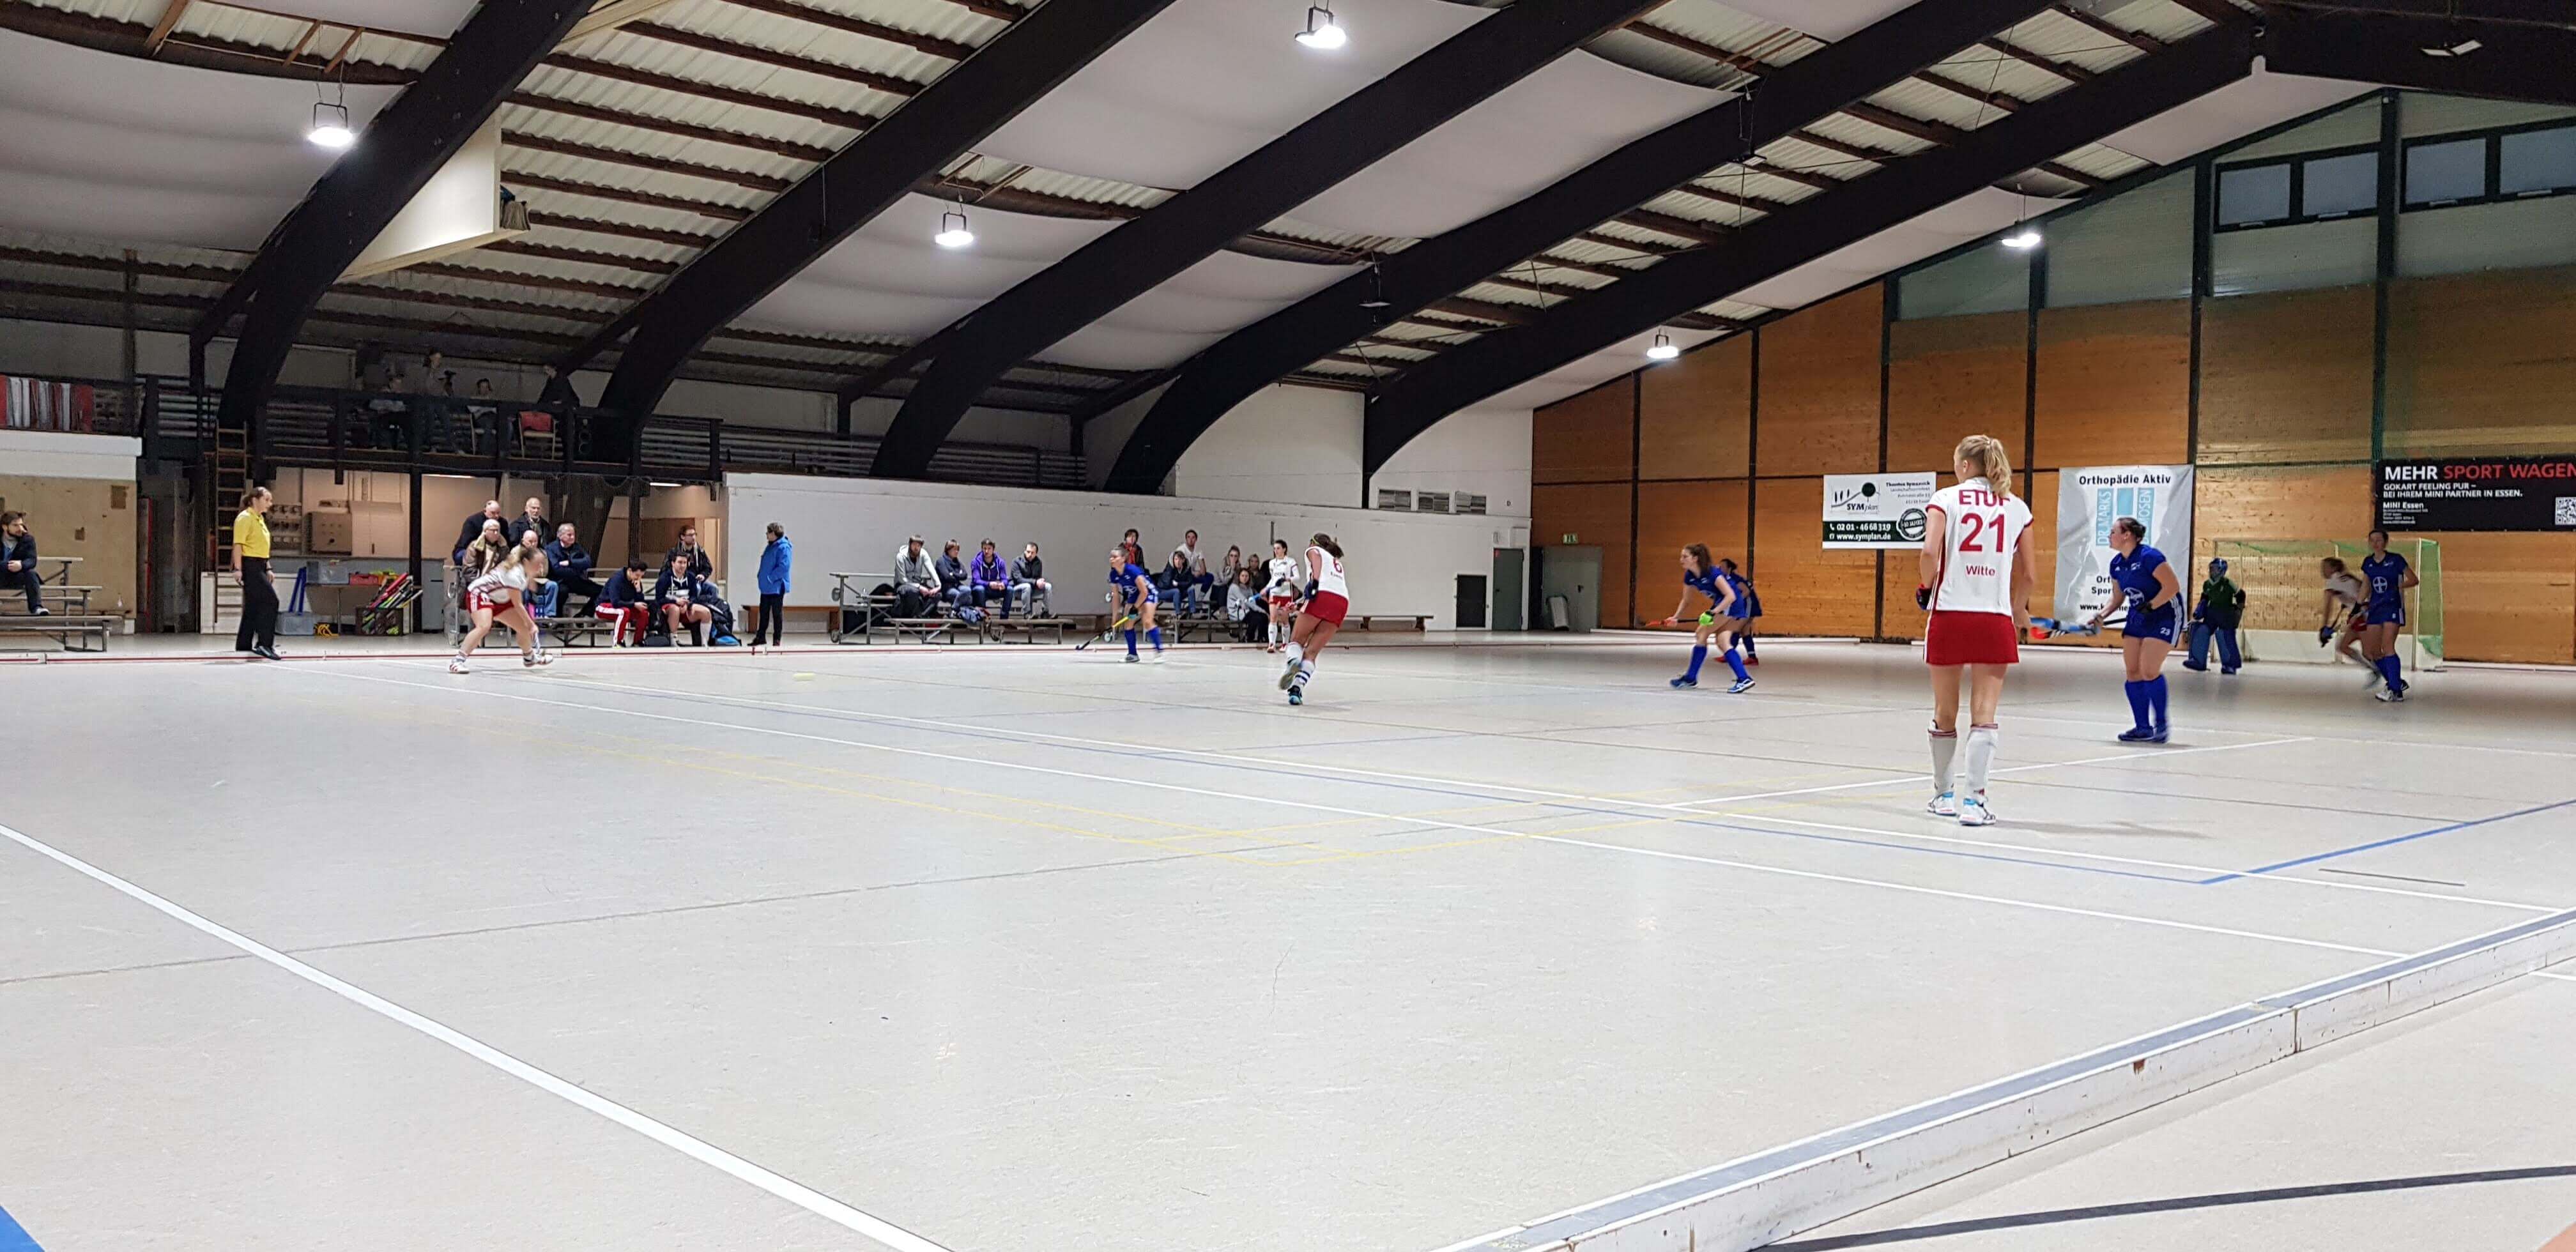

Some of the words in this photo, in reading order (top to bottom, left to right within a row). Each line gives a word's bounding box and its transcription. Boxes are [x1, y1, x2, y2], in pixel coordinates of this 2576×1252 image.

[2385, 466, 2438, 480] MEHR
[2443, 464, 2504, 479] SPORT
[2079, 475, 2139, 486] Orthopädie
[2143, 474, 2171, 484] Aktiv
[2418, 482, 2451, 491] FEELING
[2425, 490, 2444, 498] MINI
[2446, 489, 2481, 498] PARTNER
[2495, 489, 2523, 498] ESSEN.
[1836, 532, 1891, 542] www.symplan.de
[1959, 513, 2004, 553] 21
[1966, 565, 1995, 576] Witte
